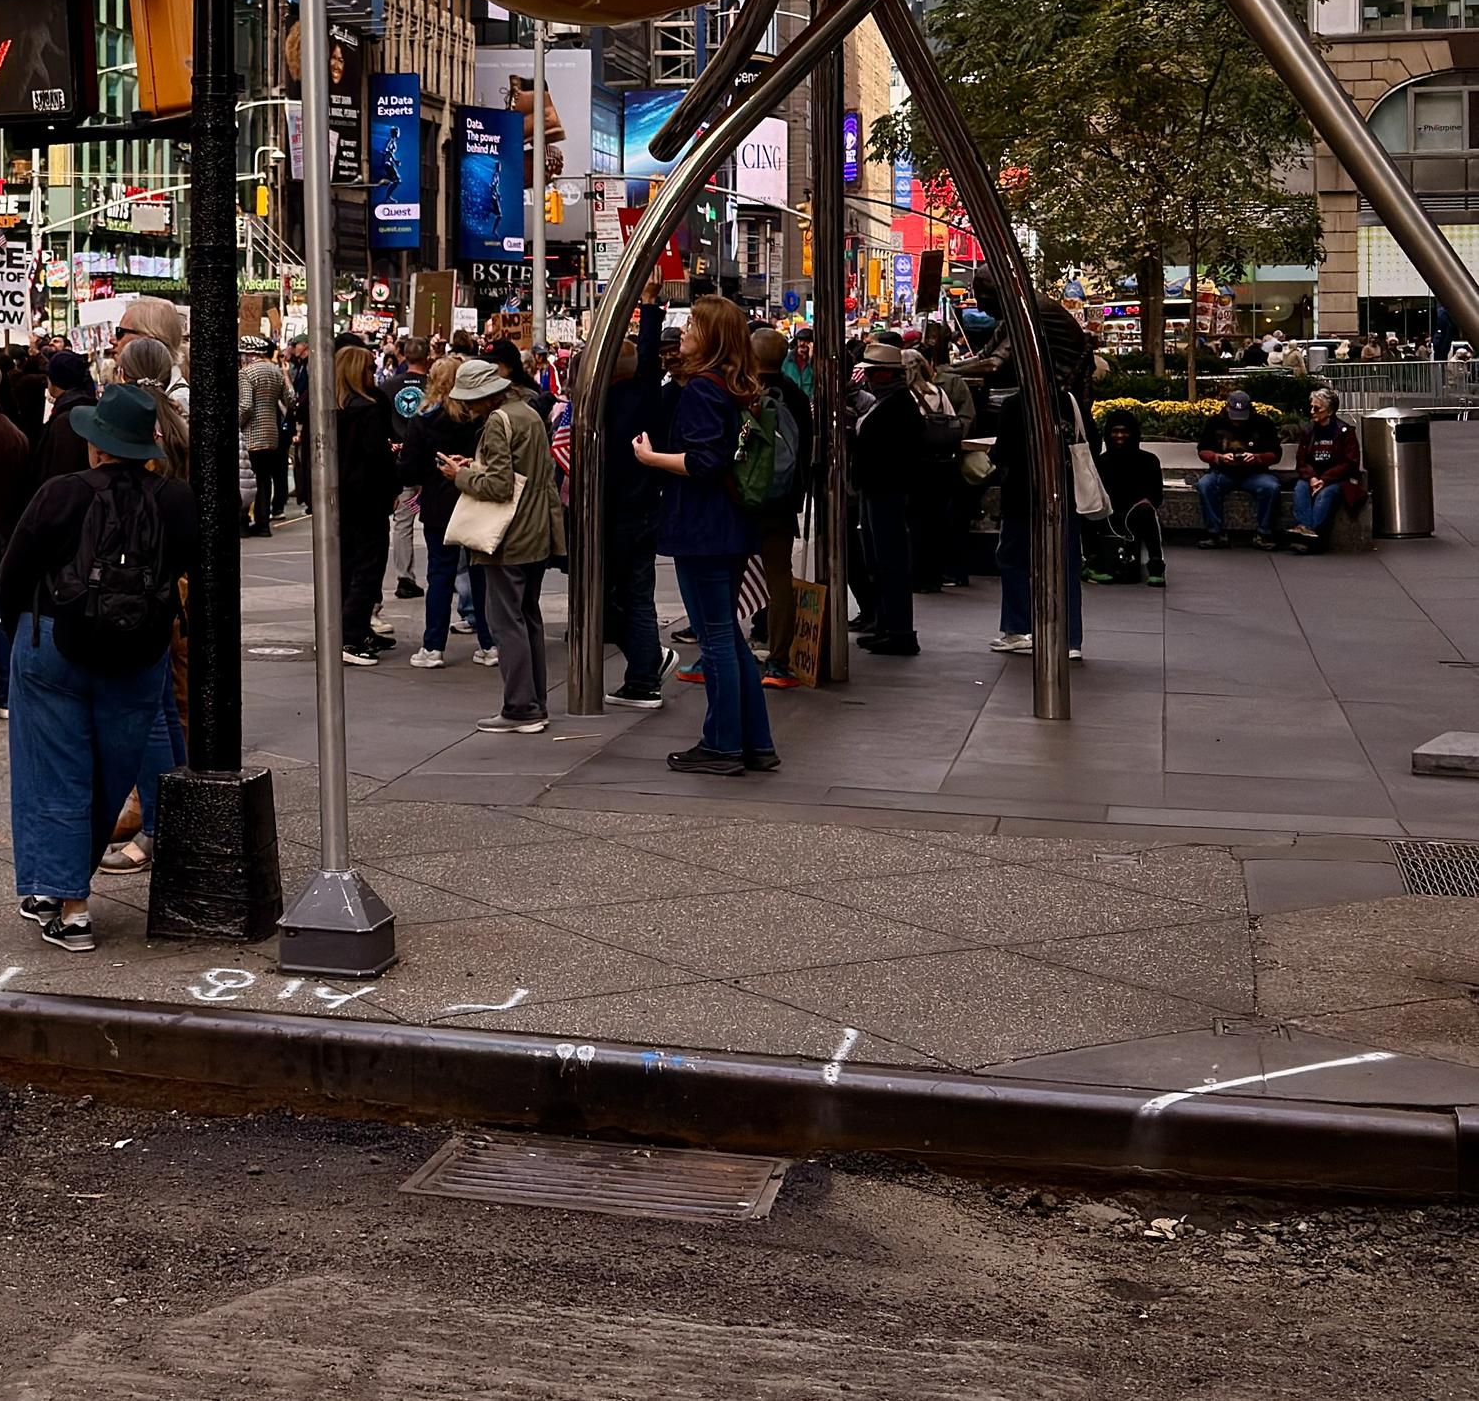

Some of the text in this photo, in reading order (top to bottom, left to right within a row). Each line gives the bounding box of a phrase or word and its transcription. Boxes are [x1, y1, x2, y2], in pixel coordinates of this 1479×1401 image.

[377, 96, 413, 106] AI Data
[377, 106, 413, 116] Experts
[466, 117, 484, 129] Data.
[466, 130, 501, 143] The power
[466, 143, 489, 154] behind
[382, 207, 412, 217] Quest
[6, 272, 25, 283] OF
